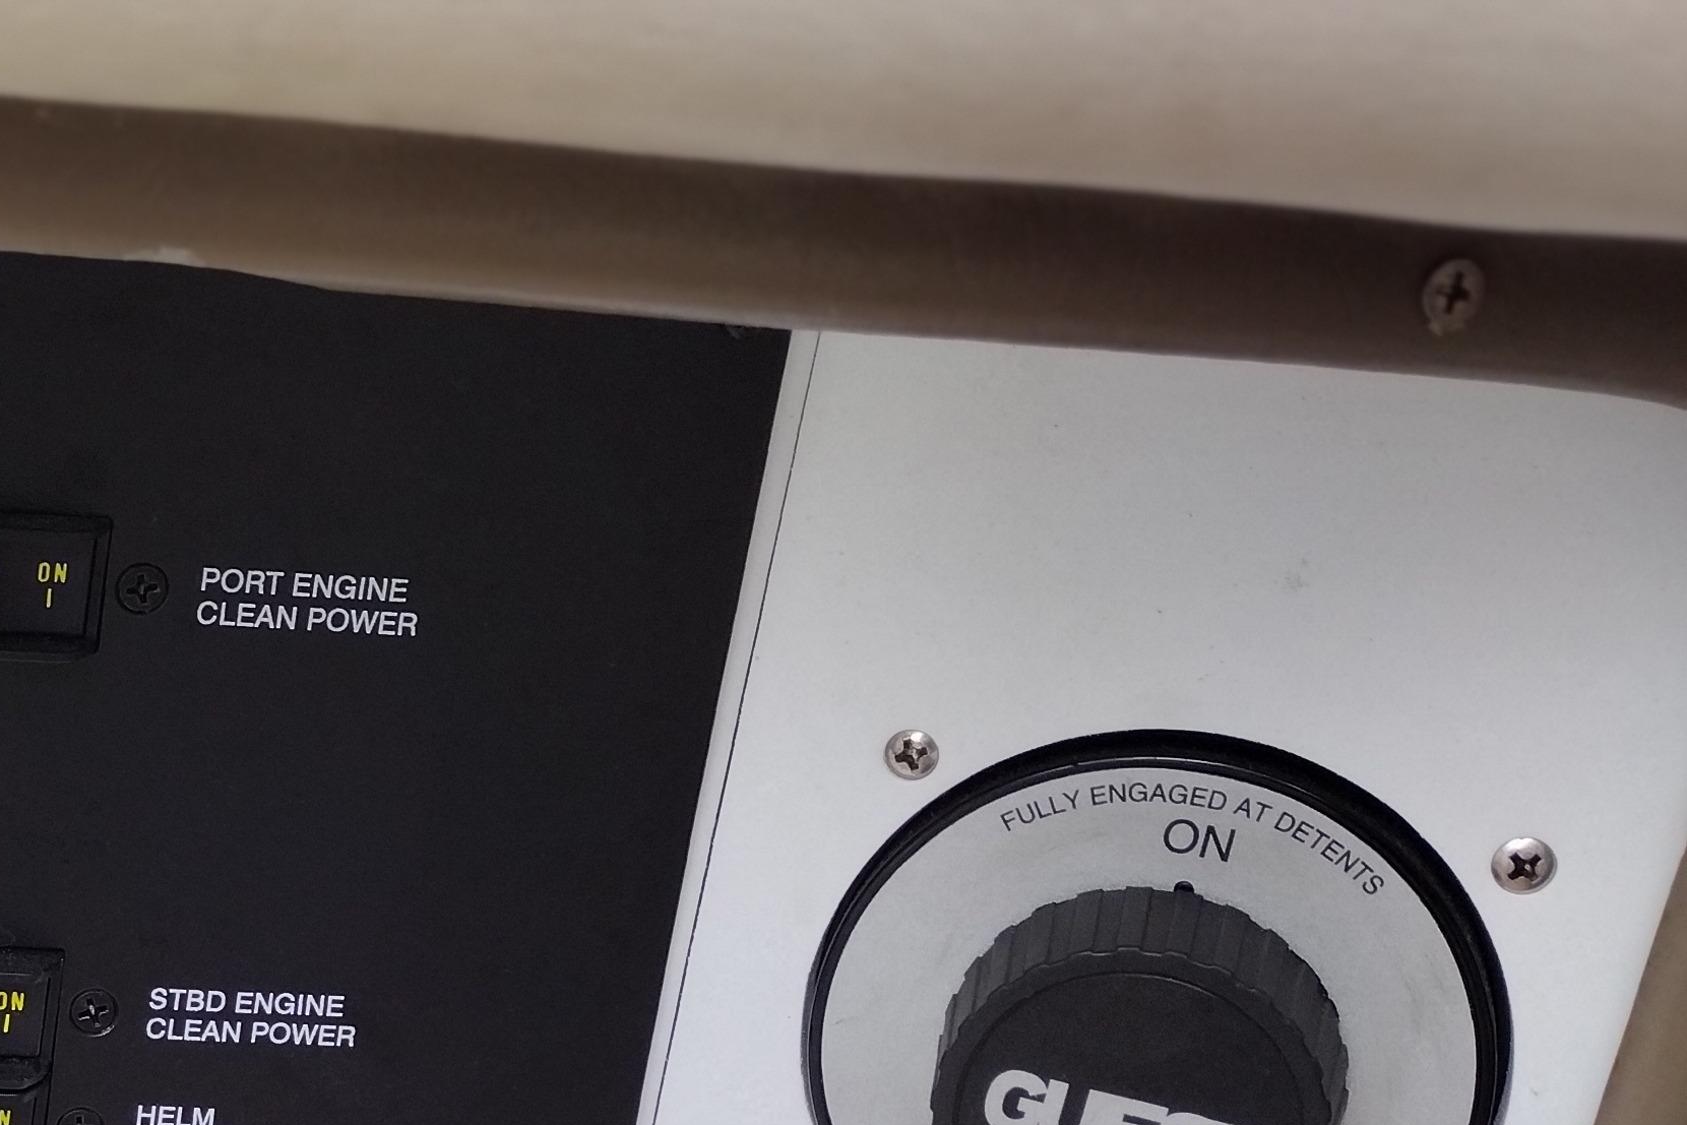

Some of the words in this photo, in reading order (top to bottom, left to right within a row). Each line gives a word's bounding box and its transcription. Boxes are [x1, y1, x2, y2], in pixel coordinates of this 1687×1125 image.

[36, 561, 69, 583] ON
[200, 566, 284, 597] PORT
[291, 572, 410, 603] ENGINE
[196, 600, 298, 632] CLEAN
[306, 606, 419, 637] POWER
[999, 788, 1081, 833] FULLY
[1090, 782, 1228, 812] ENGAGED
[1233, 797, 1274, 820] AT
[1273, 809, 1385, 897] DETENTS
[1162, 818, 1237, 863] ON
[148, 987, 226, 1014] STBD
[233, 991, 346, 1019] ENGINE
[145, 1017, 243, 1044] CLEAN
[250, 1021, 357, 1048] POWER
